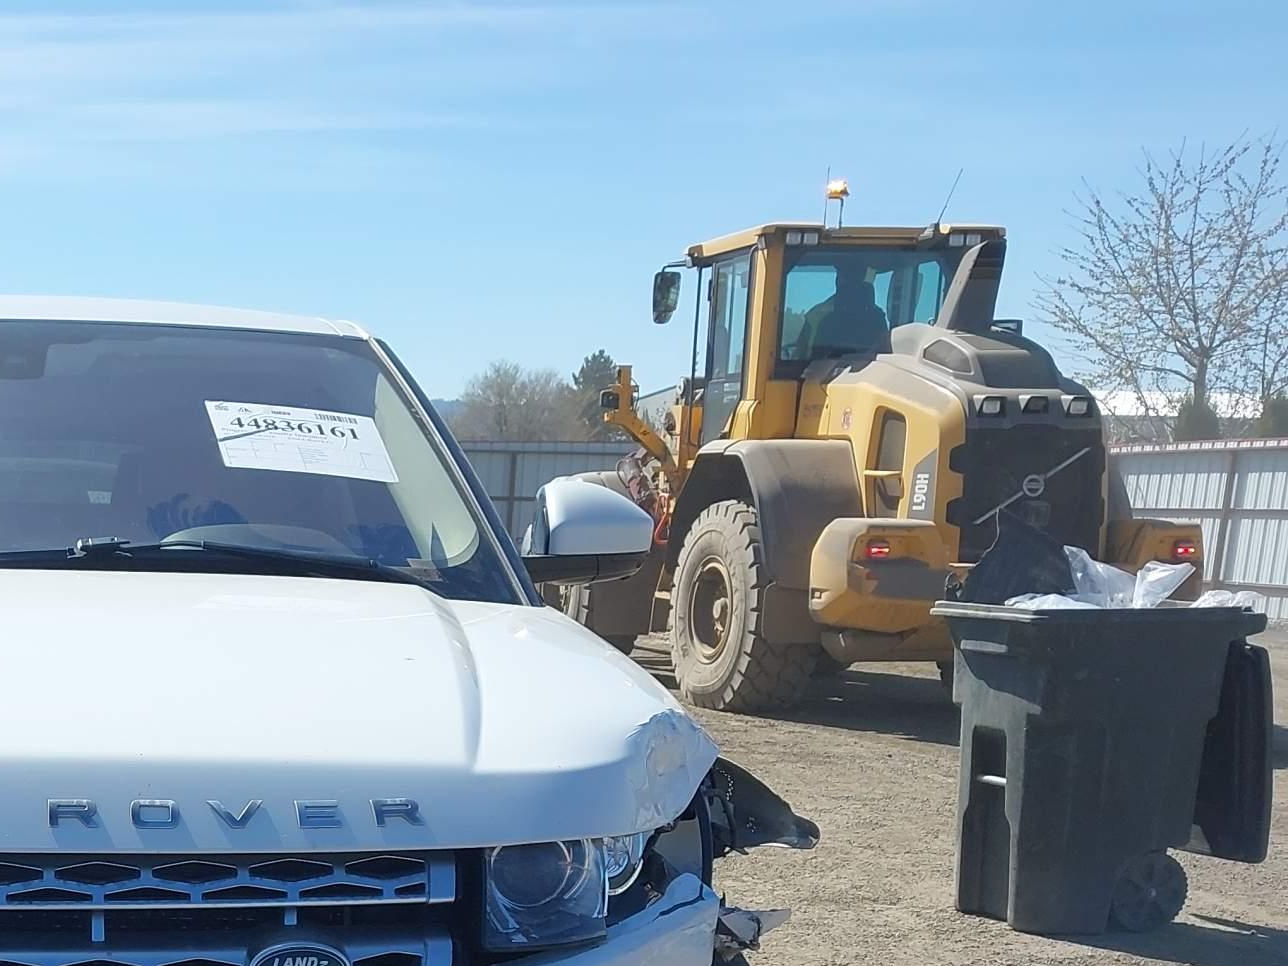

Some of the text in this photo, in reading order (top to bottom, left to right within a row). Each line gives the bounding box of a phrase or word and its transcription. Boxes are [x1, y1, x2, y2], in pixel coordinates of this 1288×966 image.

[230, 416, 360, 440] 44836161
[912, 473, 930, 511] L90H
[48, 796, 426, 829] ROVER
